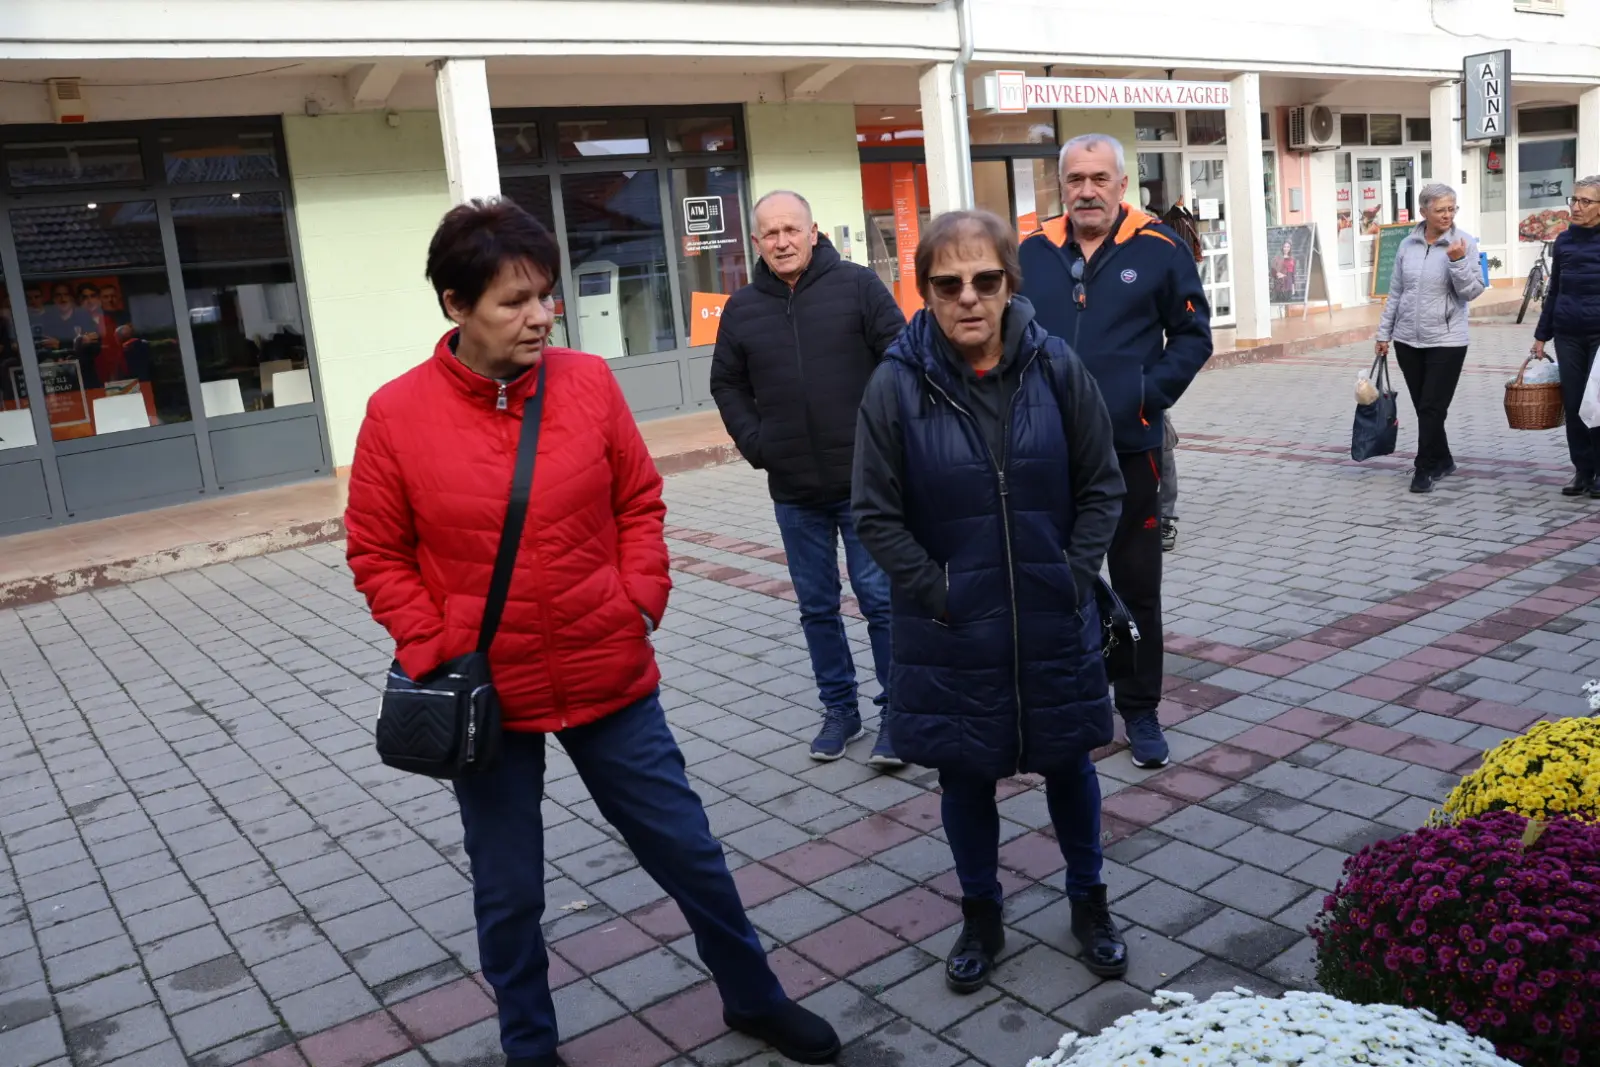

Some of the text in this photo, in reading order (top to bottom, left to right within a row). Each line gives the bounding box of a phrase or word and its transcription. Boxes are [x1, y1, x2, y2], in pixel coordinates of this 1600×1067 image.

[1025, 84, 1229, 105] PRIVREDNA BANKA ZAGREB
[1481, 63, 1500, 133] ANNA
[690, 205, 705, 217] ATM
